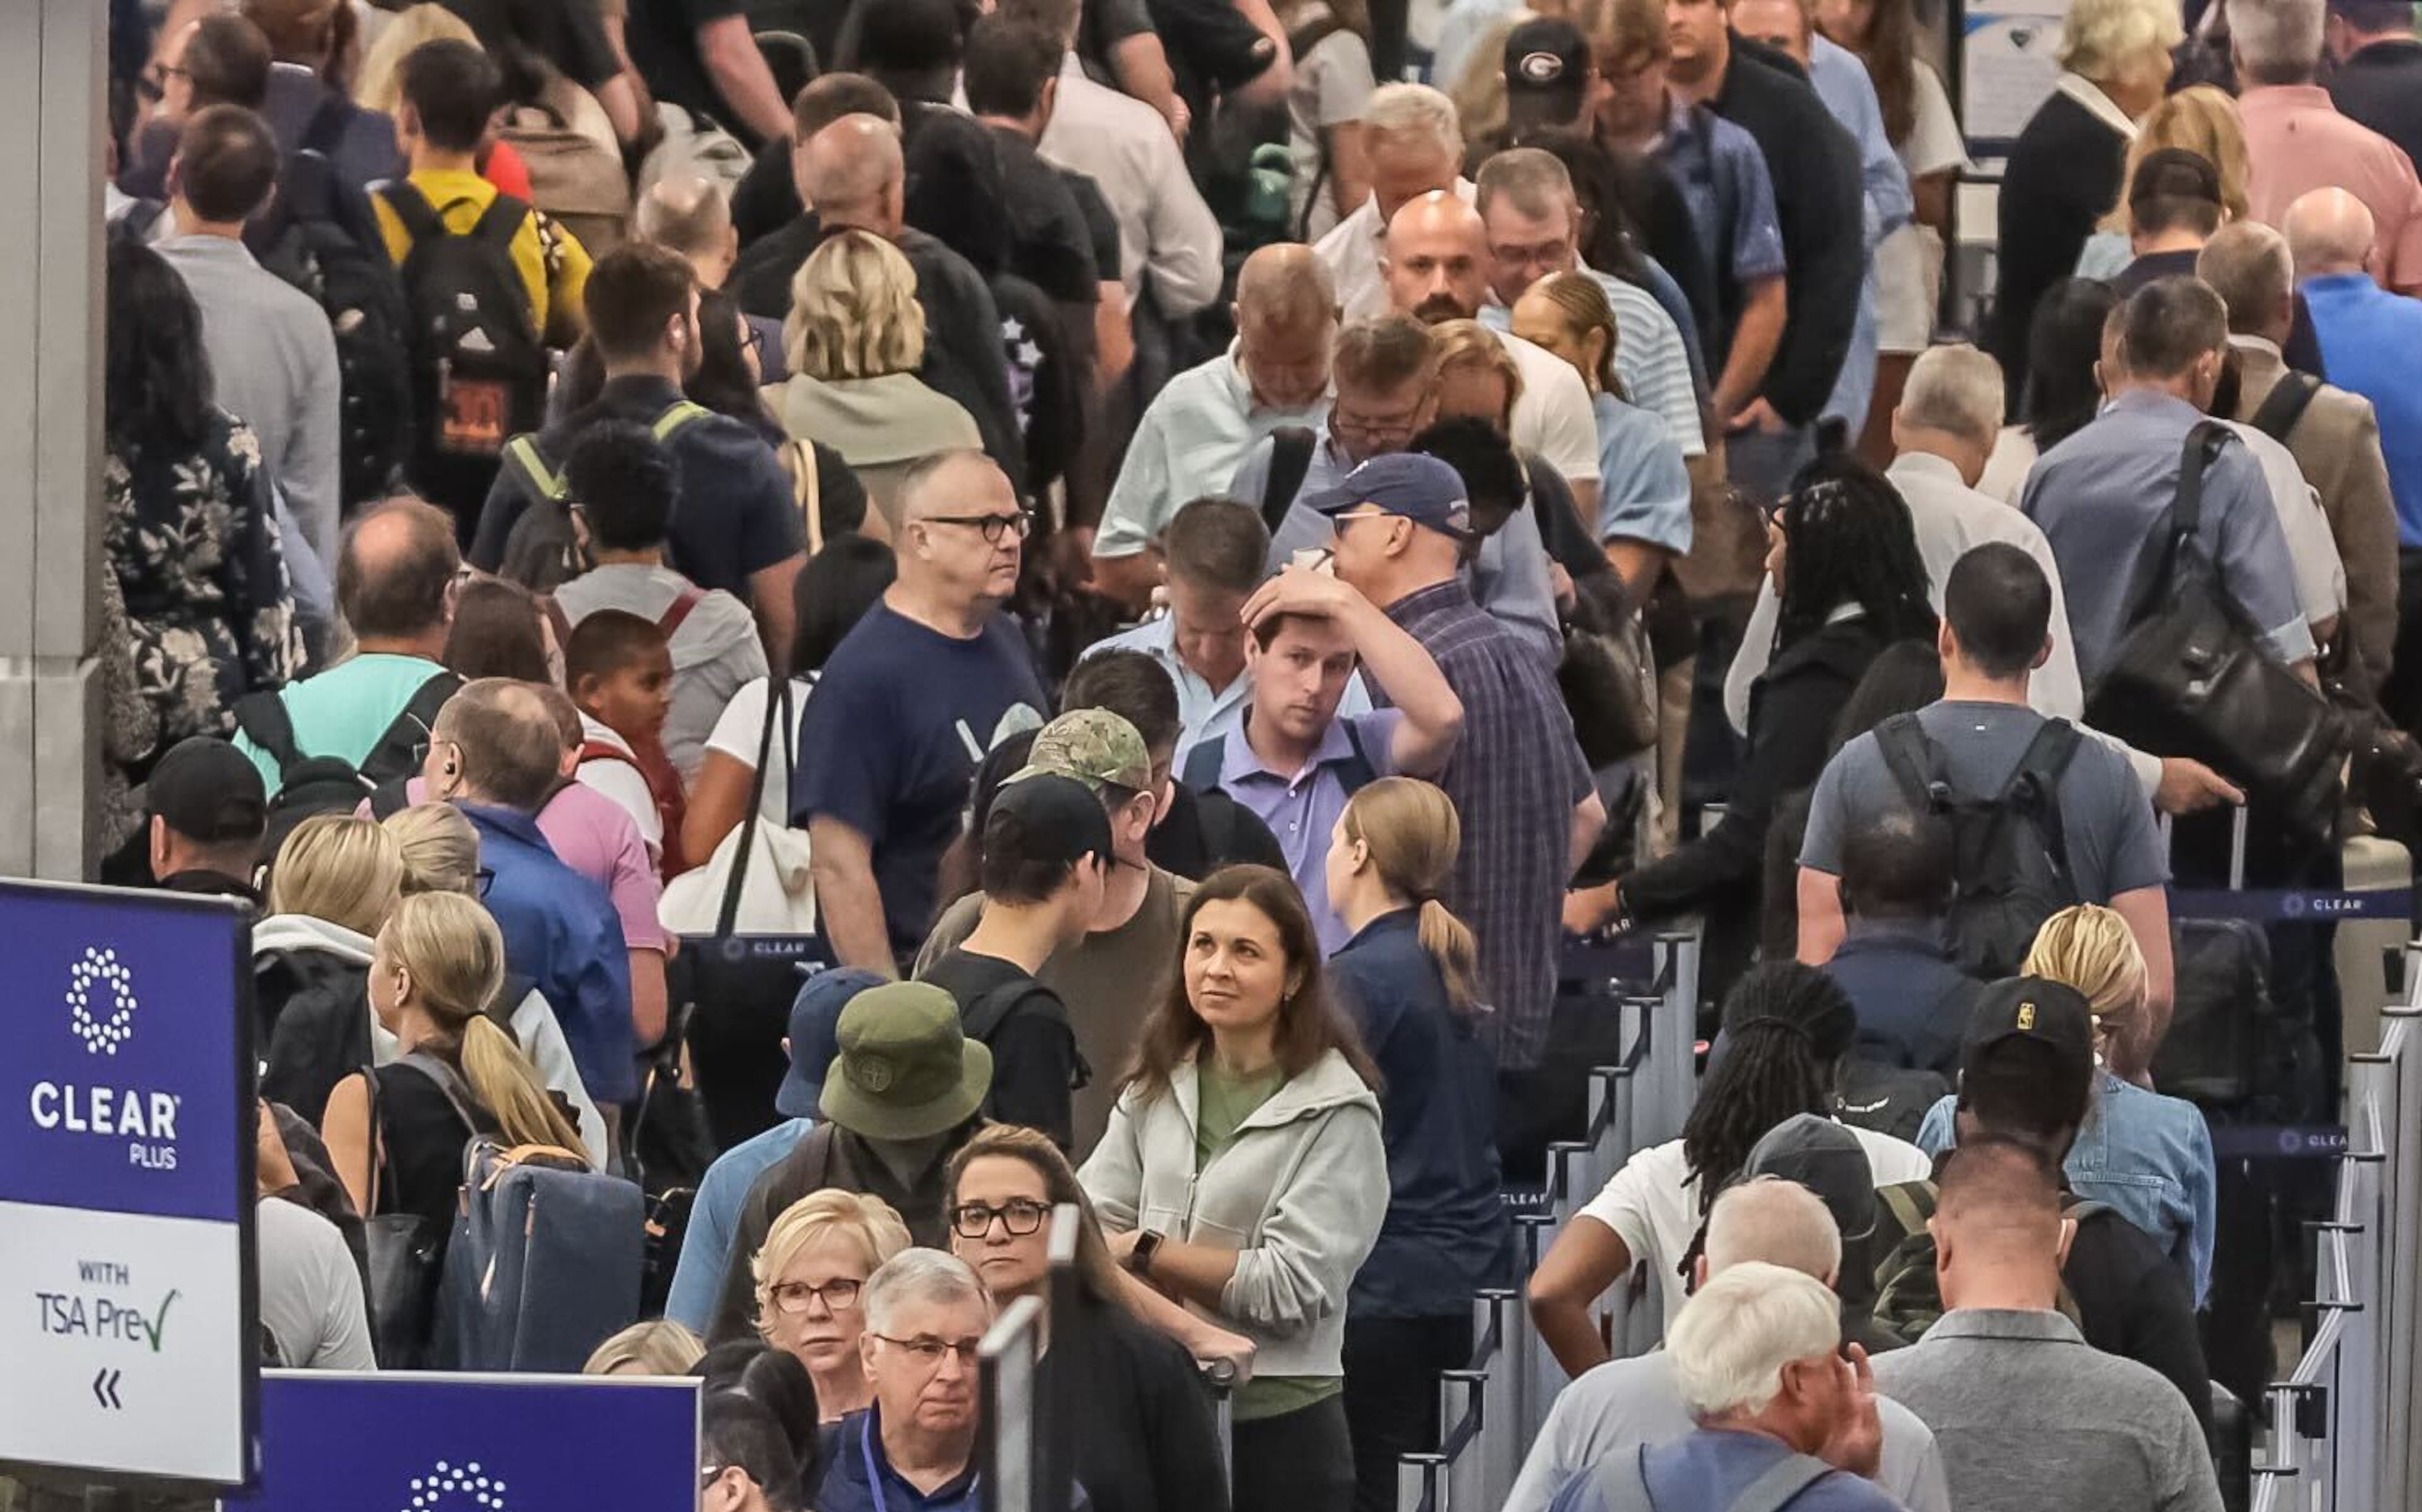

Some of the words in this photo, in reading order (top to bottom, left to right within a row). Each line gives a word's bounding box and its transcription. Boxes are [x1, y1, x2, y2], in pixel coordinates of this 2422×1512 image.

[2313, 899, 2362, 910] CLEAR
[754, 942, 805, 953] CLEAR
[31, 1081, 177, 1140] CLEAR
[2309, 1135, 2346, 1146] CLEA
[130, 1143, 177, 1170] PLUS
[77, 1260, 129, 1285] WITH
[35, 1293, 88, 1335] TSA
